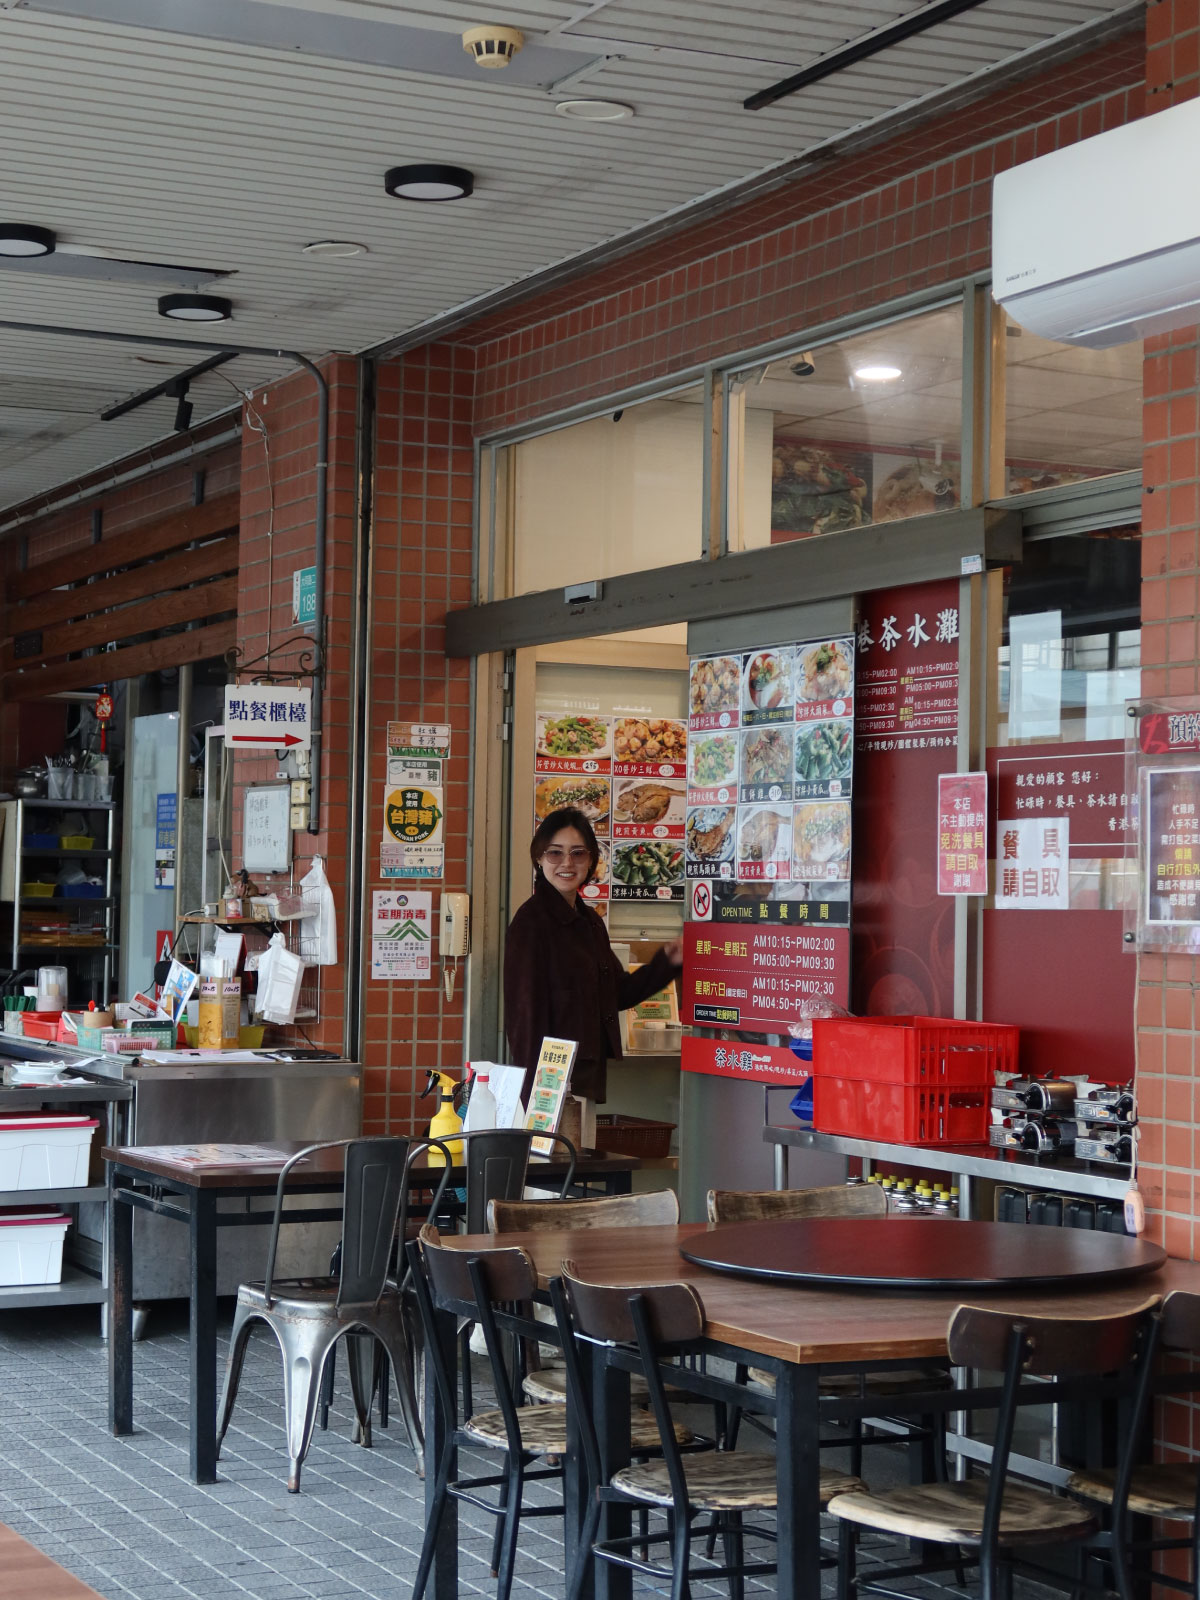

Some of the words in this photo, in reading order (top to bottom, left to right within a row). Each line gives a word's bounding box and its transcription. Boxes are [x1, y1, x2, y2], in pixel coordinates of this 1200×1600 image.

[228, 699, 307, 724] 點餐櫃檯
[1016, 772, 1066, 787] 親愛的顧客
[406, 792, 418, 800] 本店
[954, 797, 971, 810] 本店
[391, 808, 433, 825] 台灣豬
[941, 813, 984, 828] 不主動提供
[1168, 818, 1198, 830] 人手不足
[395, 830, 414, 842] TAIWAN
[414, 831, 428, 842] PORK
[940, 832, 984, 850] 免洗餐具
[1160, 834, 1200, 845] 需打包之菜
[946, 854, 978, 872] 請自取
[954, 873, 970, 888] 謝謝
[1003, 868, 1060, 898] 請自取
[378, 909, 426, 920] 定期消毒
[722, 907, 738, 918] OPEN
[738, 907, 752, 918] TIME
[760, 904, 829, 920] 點餐時間
[754, 934, 834, 951] AM10:15~PM02:00
[754, 953, 834, 970] PM05:00~PM09:30
[752, 976, 834, 995] AM10:15~PM02:30
